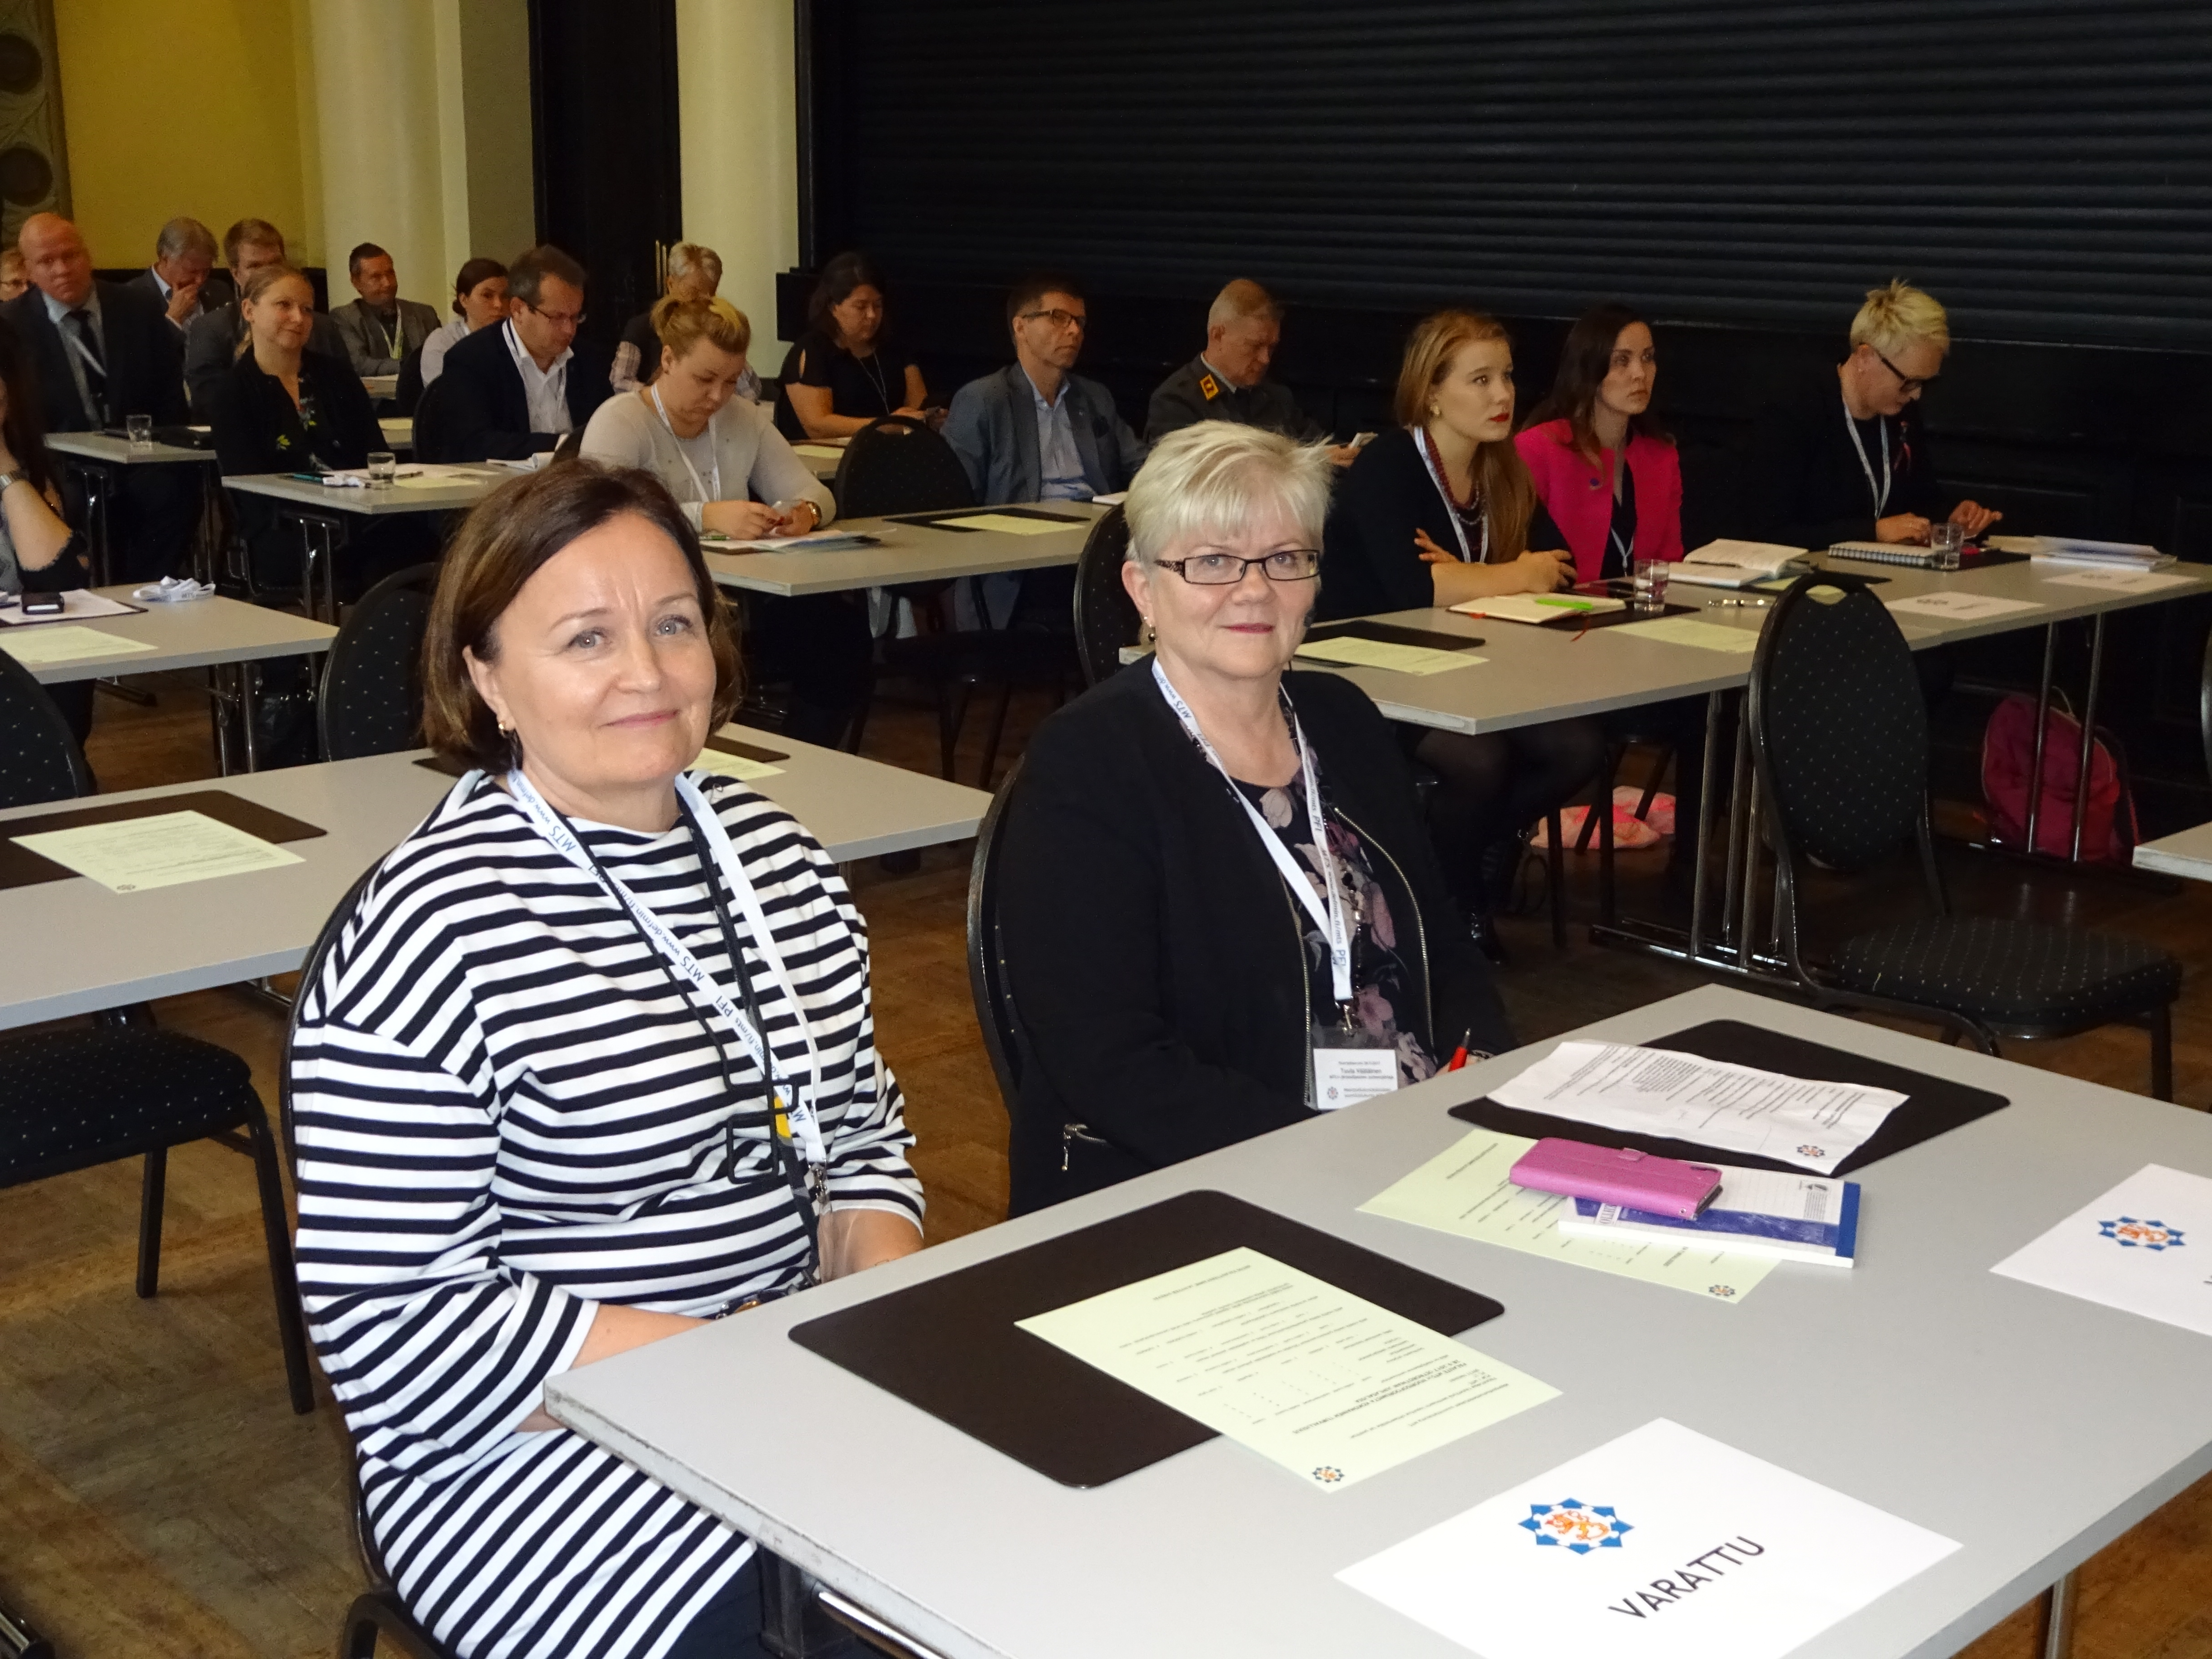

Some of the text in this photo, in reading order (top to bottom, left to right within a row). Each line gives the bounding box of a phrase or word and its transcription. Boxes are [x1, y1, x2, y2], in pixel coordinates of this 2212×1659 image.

[1175, 700, 1192, 718] MTS
[1312, 815, 1322, 831] PFI
[548, 825, 577, 852] MTS
[1336, 949, 1347, 966] PFI
[680, 956, 705, 982] MTS
[715, 995, 733, 1017] PFI
[1607, 1535, 1765, 1618] VARATTU
